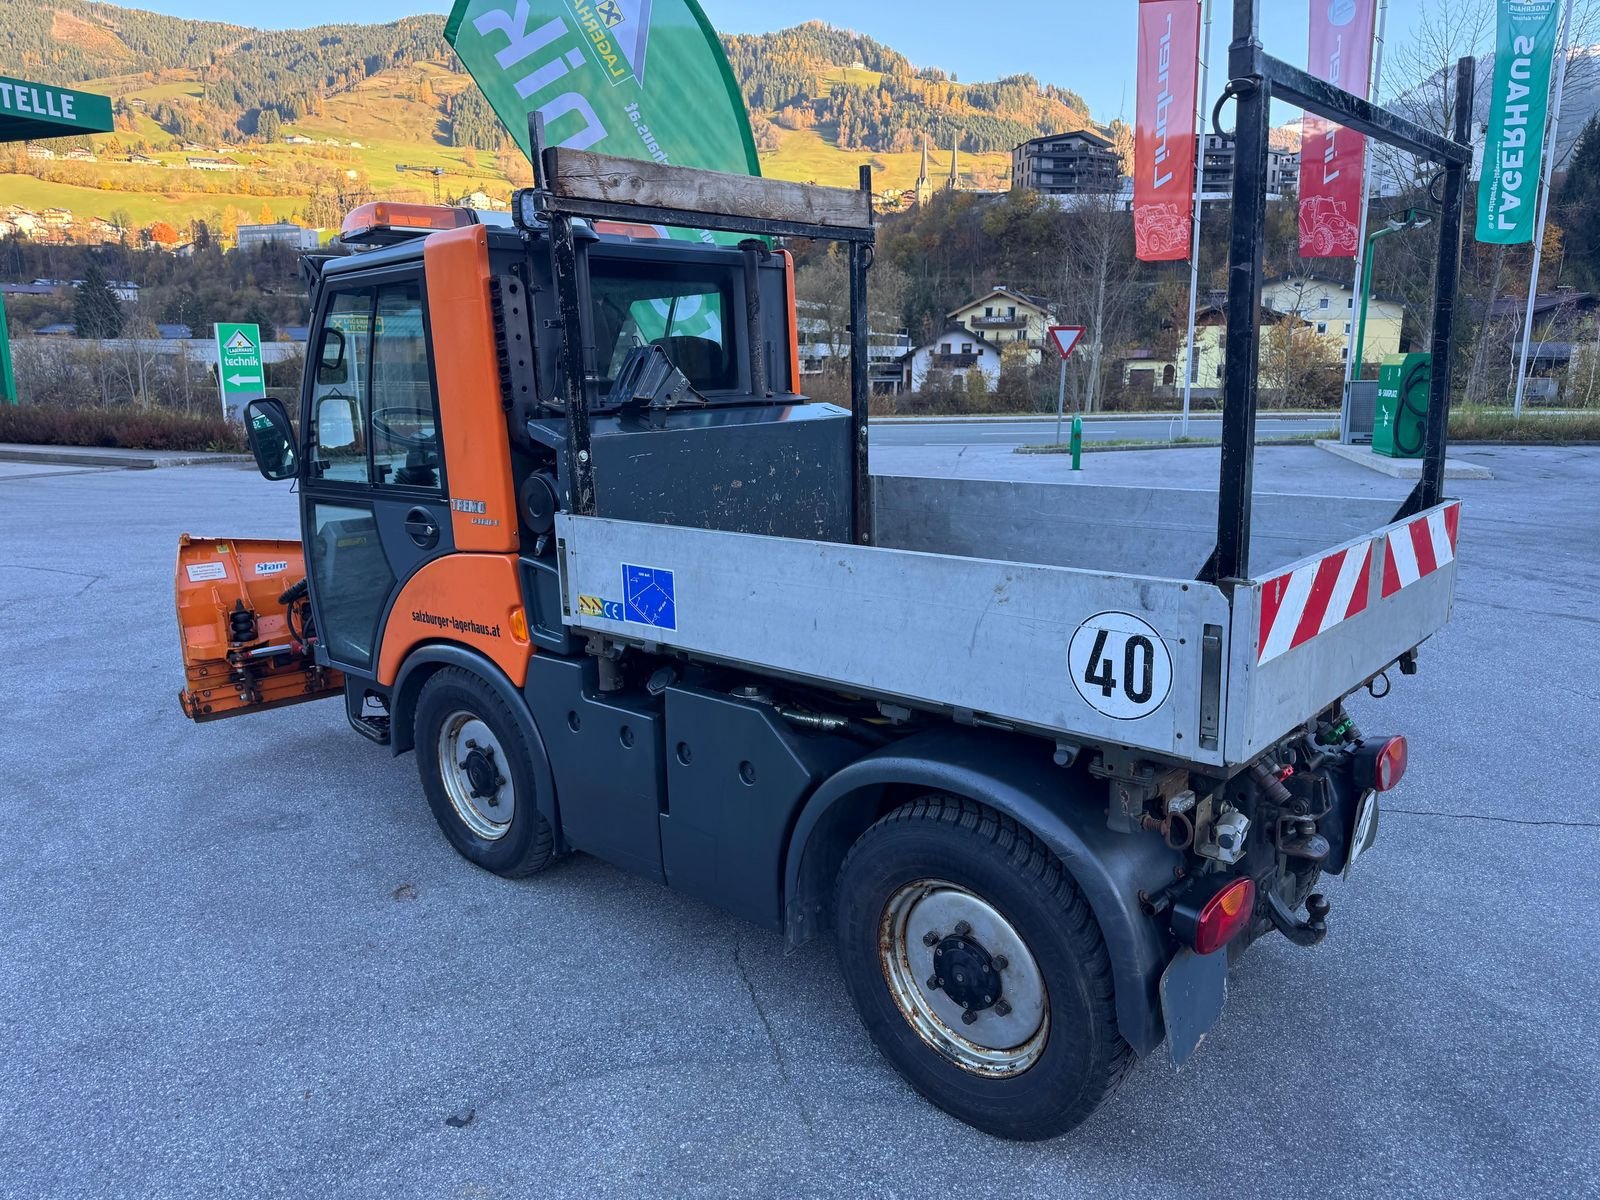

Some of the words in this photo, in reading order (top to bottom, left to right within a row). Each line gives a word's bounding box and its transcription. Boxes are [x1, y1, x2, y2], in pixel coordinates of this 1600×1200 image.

[0, 82, 77, 120] TELLE
[224, 356, 259, 367] technik
[451, 498, 486, 514] TREMO
[411, 610, 501, 638] salzburger-lagerhaus.at
[1084, 629, 1154, 704] 40
